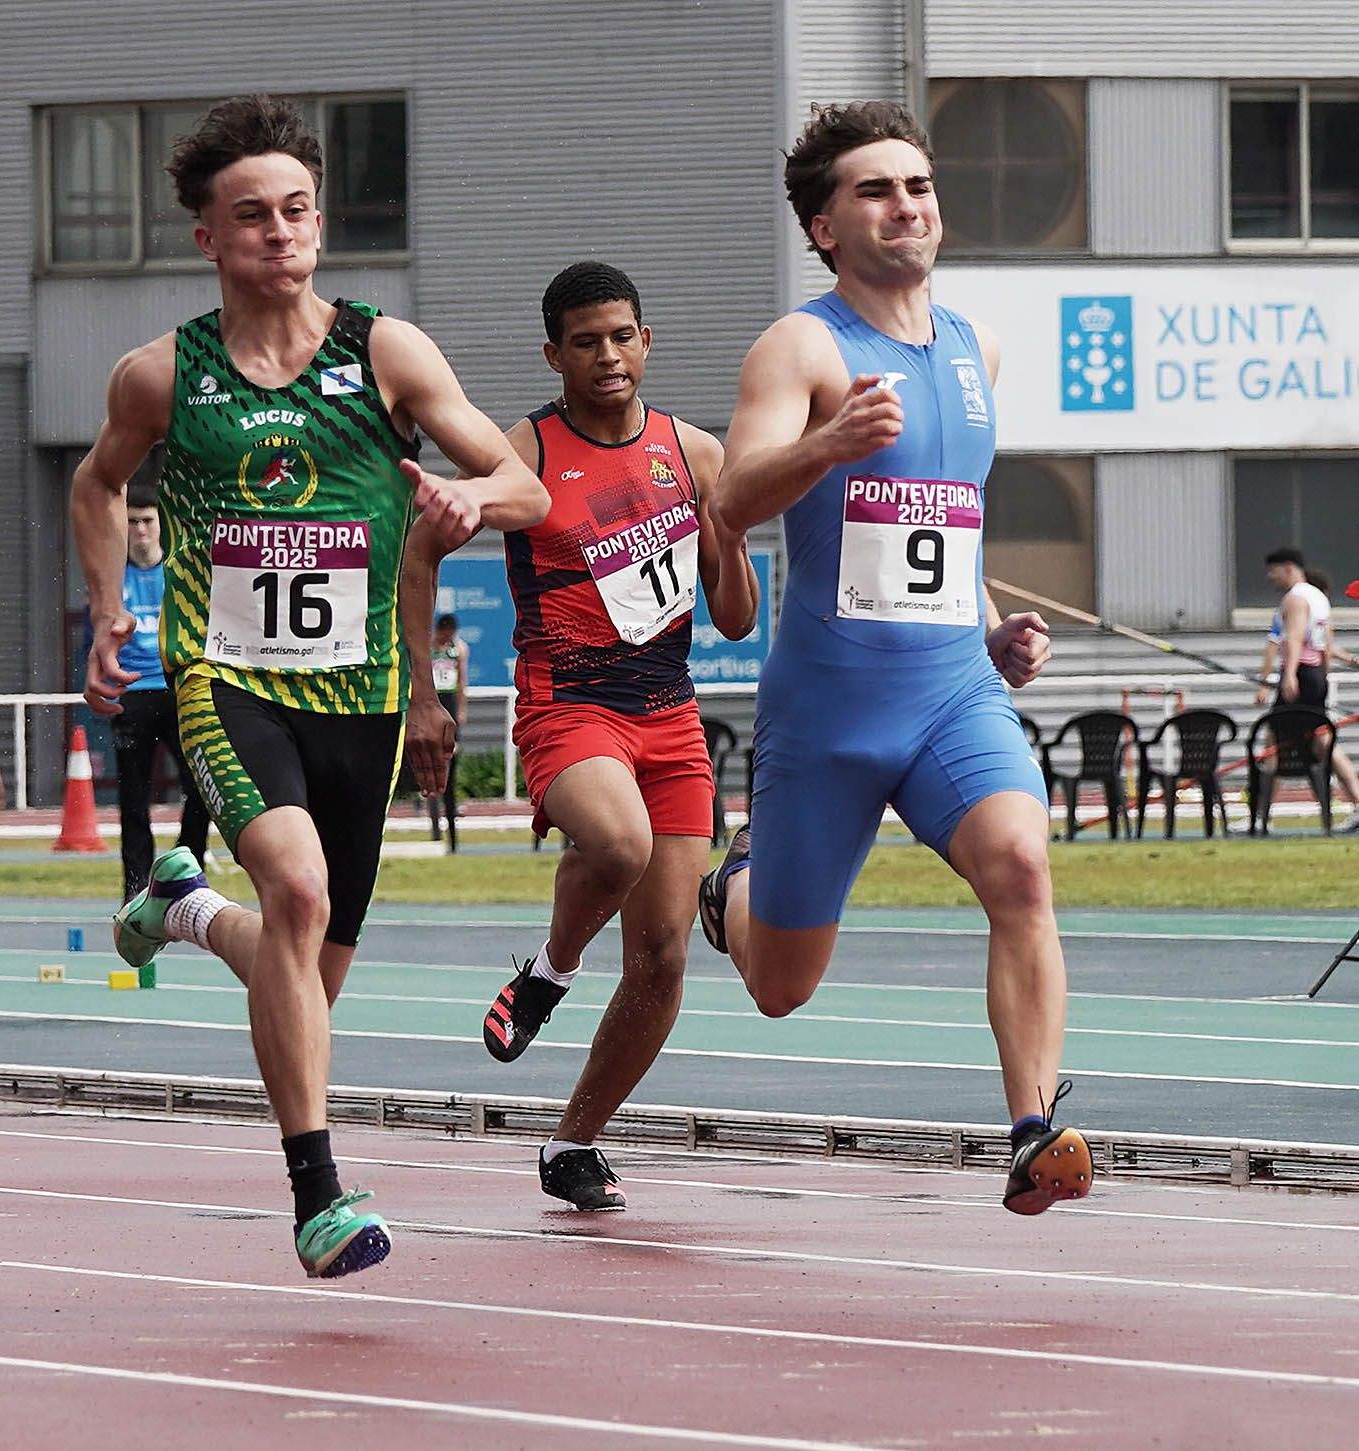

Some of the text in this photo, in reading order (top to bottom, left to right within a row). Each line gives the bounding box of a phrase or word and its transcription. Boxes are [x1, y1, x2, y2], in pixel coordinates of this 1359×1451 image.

[1157, 303, 1328, 346] XUNTA
[1156, 357, 1359, 401] DE GALI
[188, 394, 232, 406] VIATOR
[239, 409, 306, 431] LUCUS
[849, 481, 979, 510] PONTEVEDRA
[897, 504, 947, 525] 2025
[214, 523, 367, 549] PONTEVEDRA
[584, 502, 694, 565] PONTEVEDRA
[629, 531, 670, 563] 2025
[260, 548, 318, 568] 2025
[906, 529, 944, 595] 9
[639, 547, 680, 609] 11
[252, 571, 333, 639] 16
[893, 600, 944, 612] atletismo.gal
[259, 645, 315, 657] atletismo.gal
[193, 746, 225, 816] LUCUS
